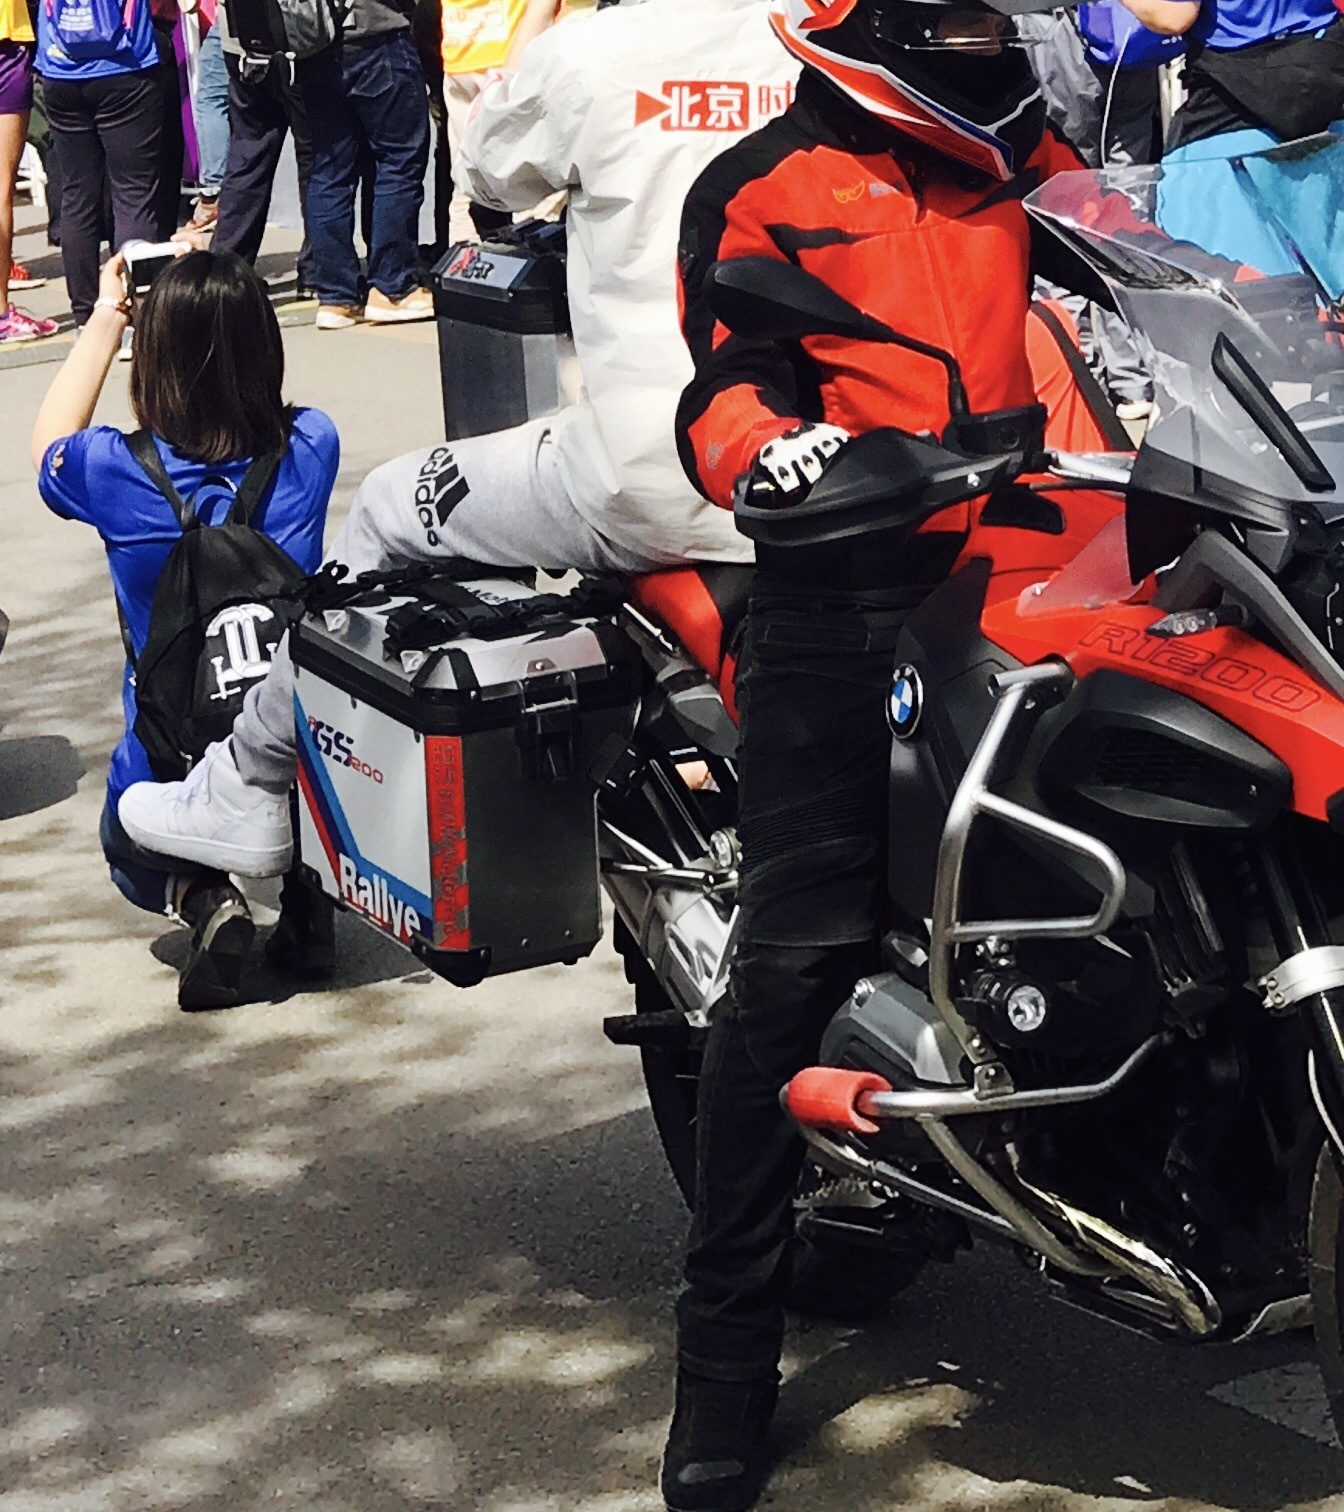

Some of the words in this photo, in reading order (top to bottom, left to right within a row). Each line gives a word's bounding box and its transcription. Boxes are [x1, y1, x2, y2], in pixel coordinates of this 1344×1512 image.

[669, 80, 801, 129] 北京时
[1078, 620, 1322, 713] R1200
[339, 852, 422, 939] Rallye
